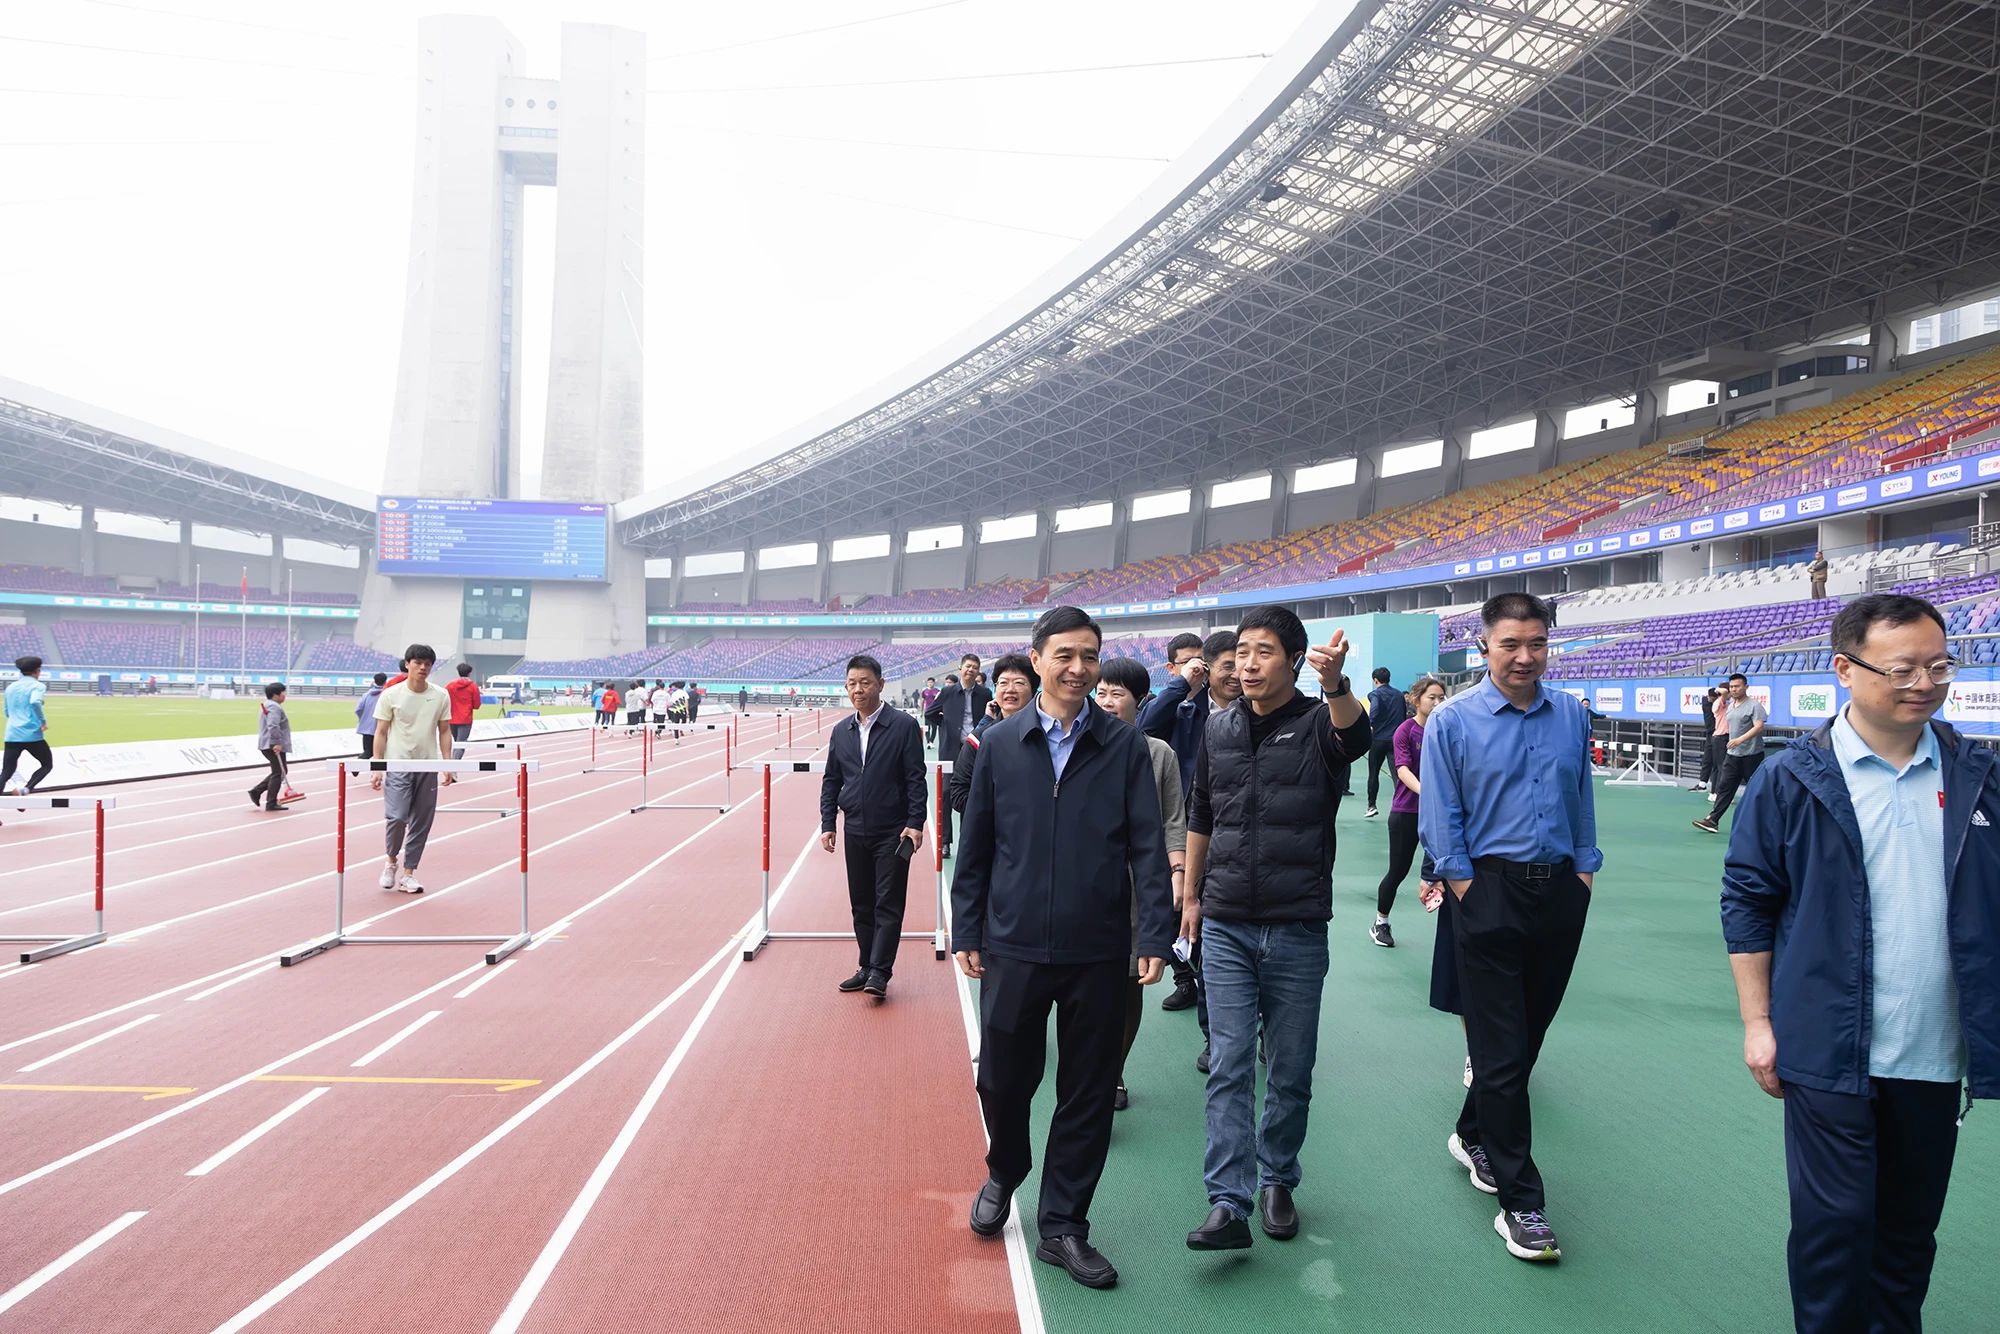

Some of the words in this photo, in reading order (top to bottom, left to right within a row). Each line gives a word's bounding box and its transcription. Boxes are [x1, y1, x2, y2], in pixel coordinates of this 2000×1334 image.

[1965, 692, 2000, 703] 中国体育彩
[179, 747, 218, 765] NIO
